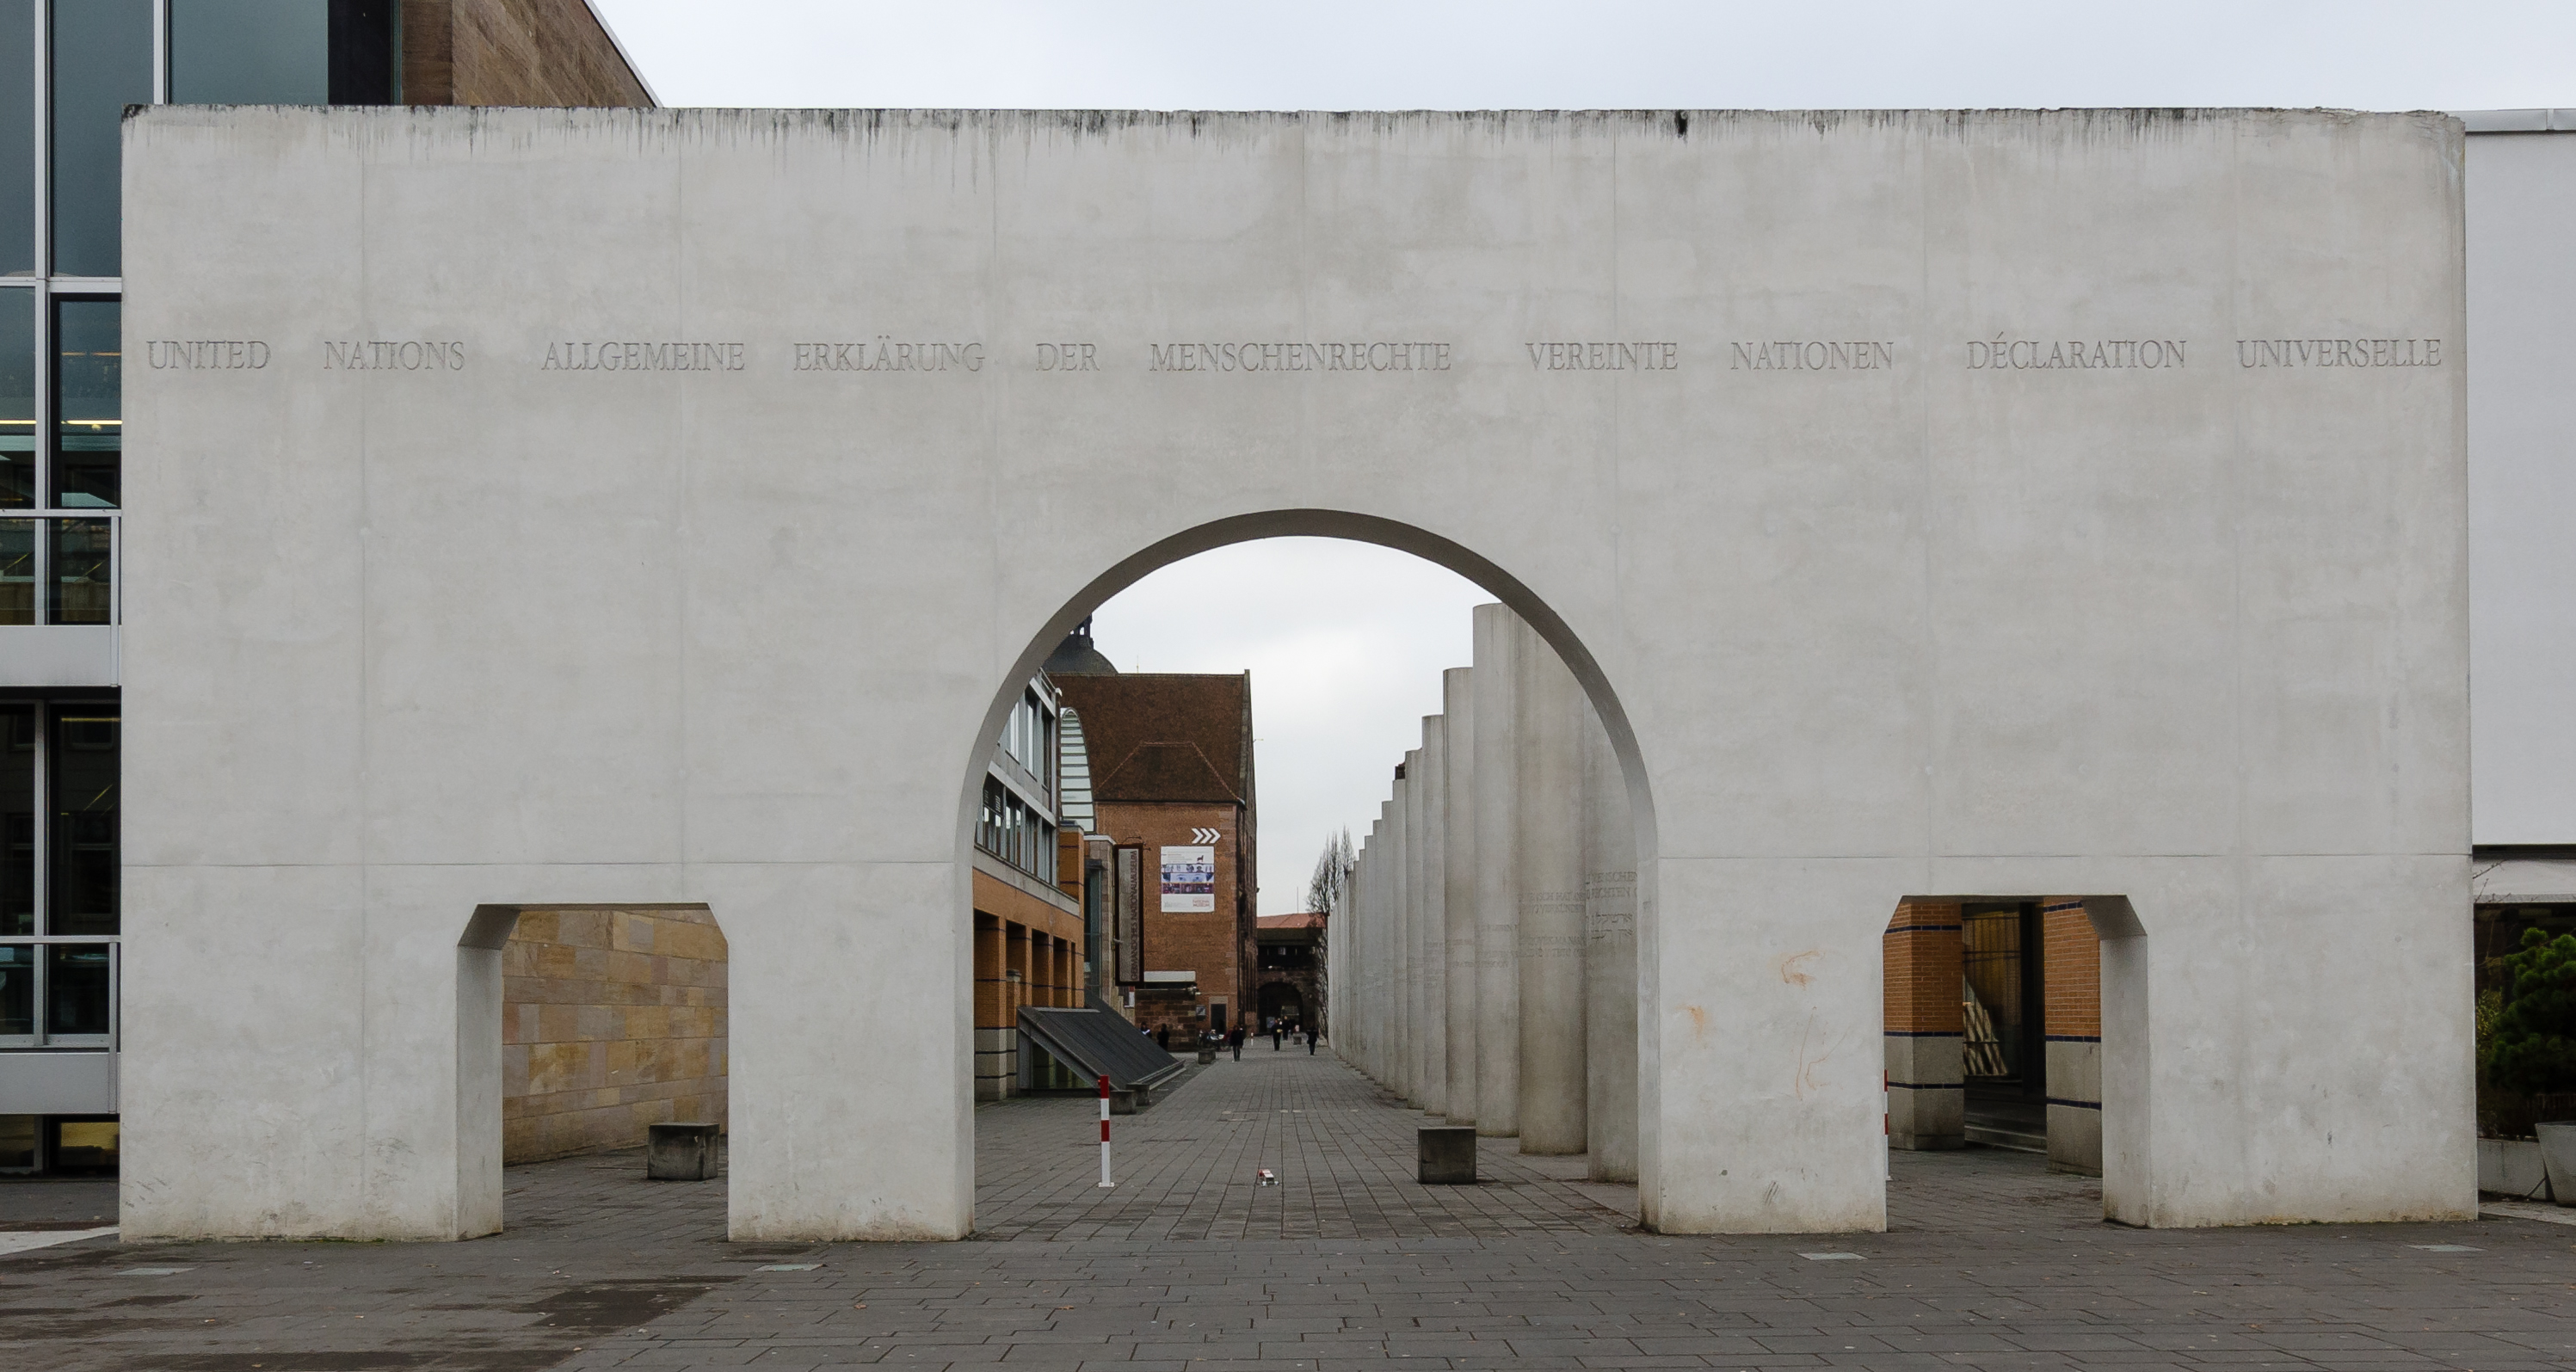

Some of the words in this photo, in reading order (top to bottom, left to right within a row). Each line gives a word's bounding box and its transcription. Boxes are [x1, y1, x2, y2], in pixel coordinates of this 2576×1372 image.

[146, 339, 271, 370] UNITED
[324, 340, 465, 371] NATIONS
[541, 341, 745, 372] ALLGEMEINE
[792, 335, 985, 372] ERKLÄRUNG
[1035, 341, 1100, 372] DER
[1149, 341, 1451, 372] MENSCHENRECHTE
[1525, 341, 1679, 371] VEREINTE
[1730, 341, 1894, 371] NATIONEN
[1966, 331, 2187, 371] DÉCLARATION
[2236, 338, 2443, 368] UNIVERSELLE
[1130, 850, 1138, 921] NATIONALMUSEUM
